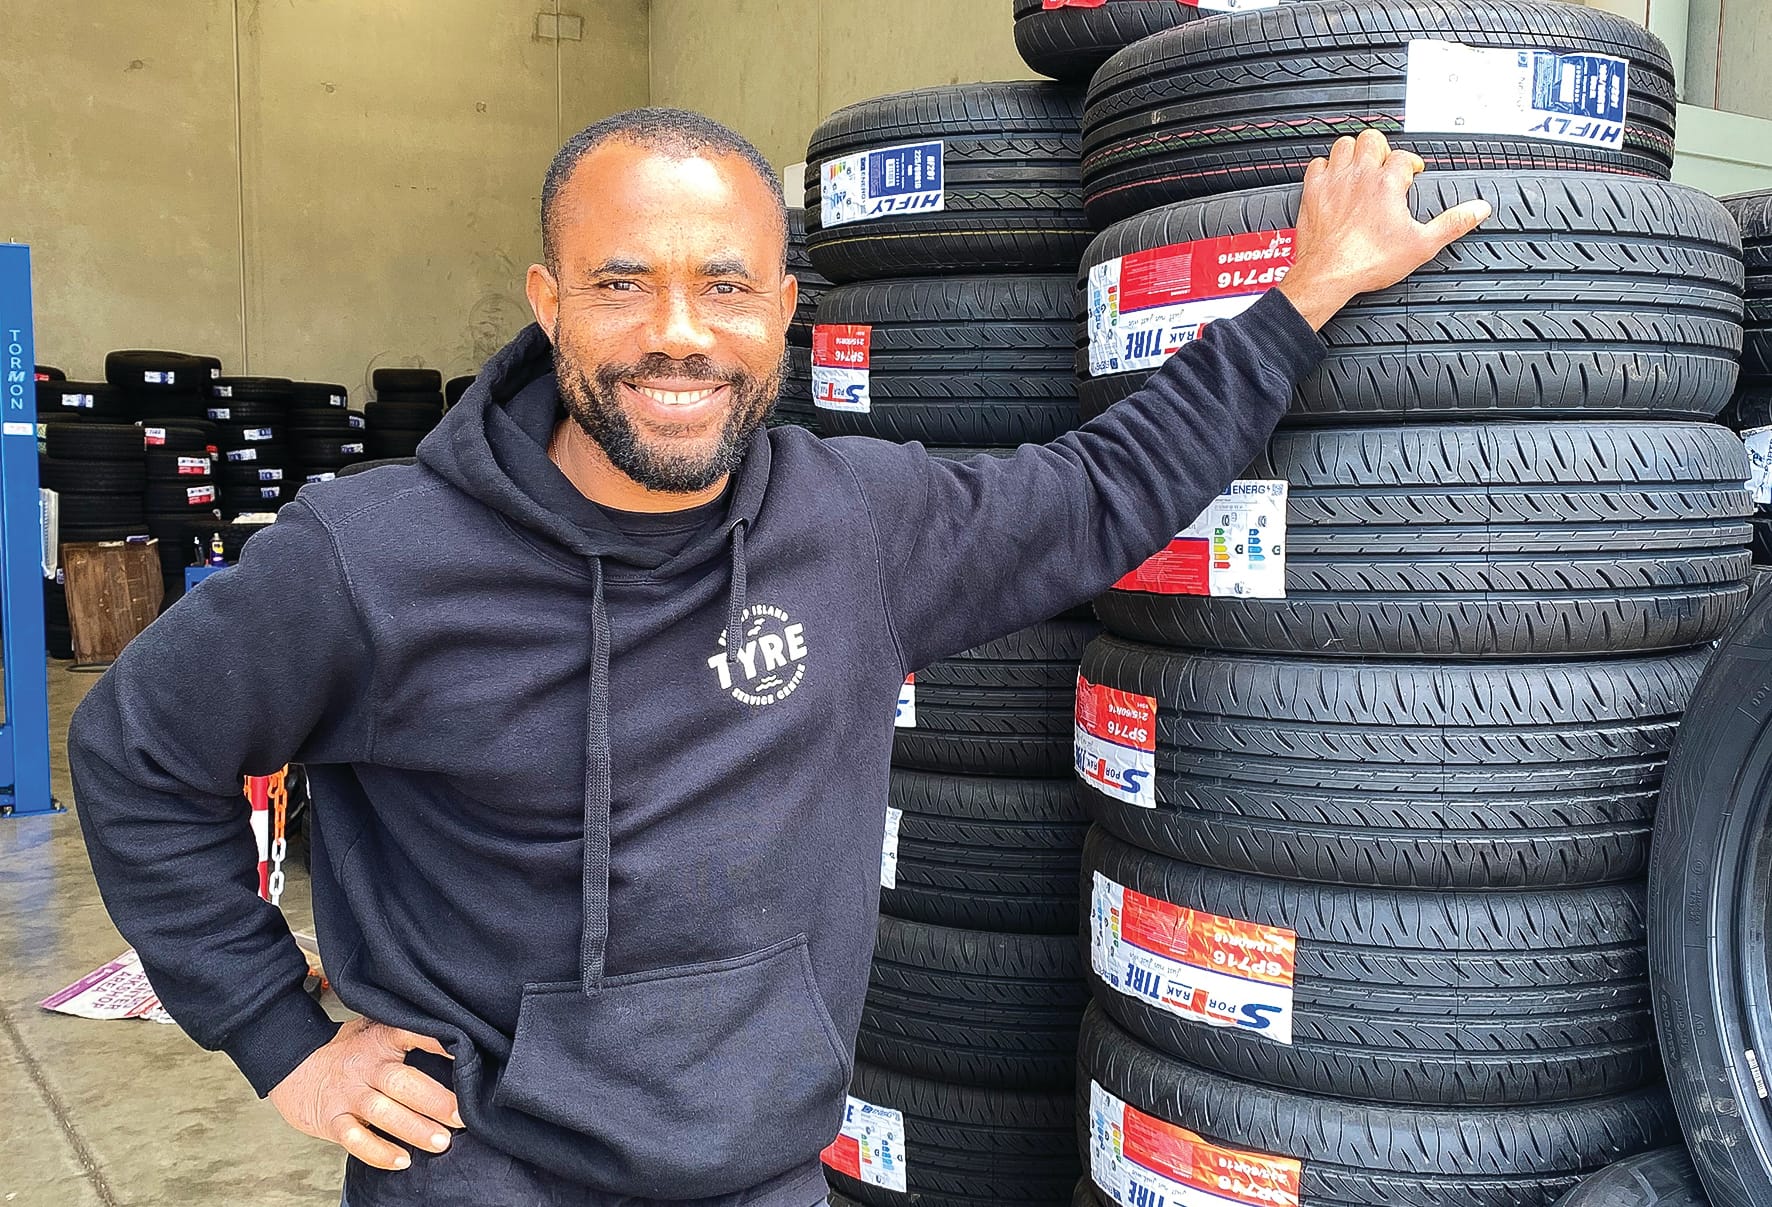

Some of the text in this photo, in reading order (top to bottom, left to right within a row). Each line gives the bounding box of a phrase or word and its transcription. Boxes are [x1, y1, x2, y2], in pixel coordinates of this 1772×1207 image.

[1528, 117, 1622, 143] HIFLY
[866, 193, 941, 216] HIFLY
[1218, 247, 1291, 264] 215/60R16
[1217, 266, 1289, 288] SP716
[835, 351, 864, 362] SP716
[1125, 329, 1162, 360] TIRE
[7, 329, 25, 411] TORMON
[1232, 484, 1266, 494] ENERG
[752, 604, 789, 622] ISLAND
[707, 622, 808, 690] TYRE
[1108, 704, 1148, 720] 215/60R16
[1107, 721, 1147, 742] SP716
[1213, 950, 1281, 976] SP716
[93, 971, 146, 1008] RKSHOP
[1125, 963, 1160, 999] TIRE
[1694, 1012, 1706, 1037] SUV
